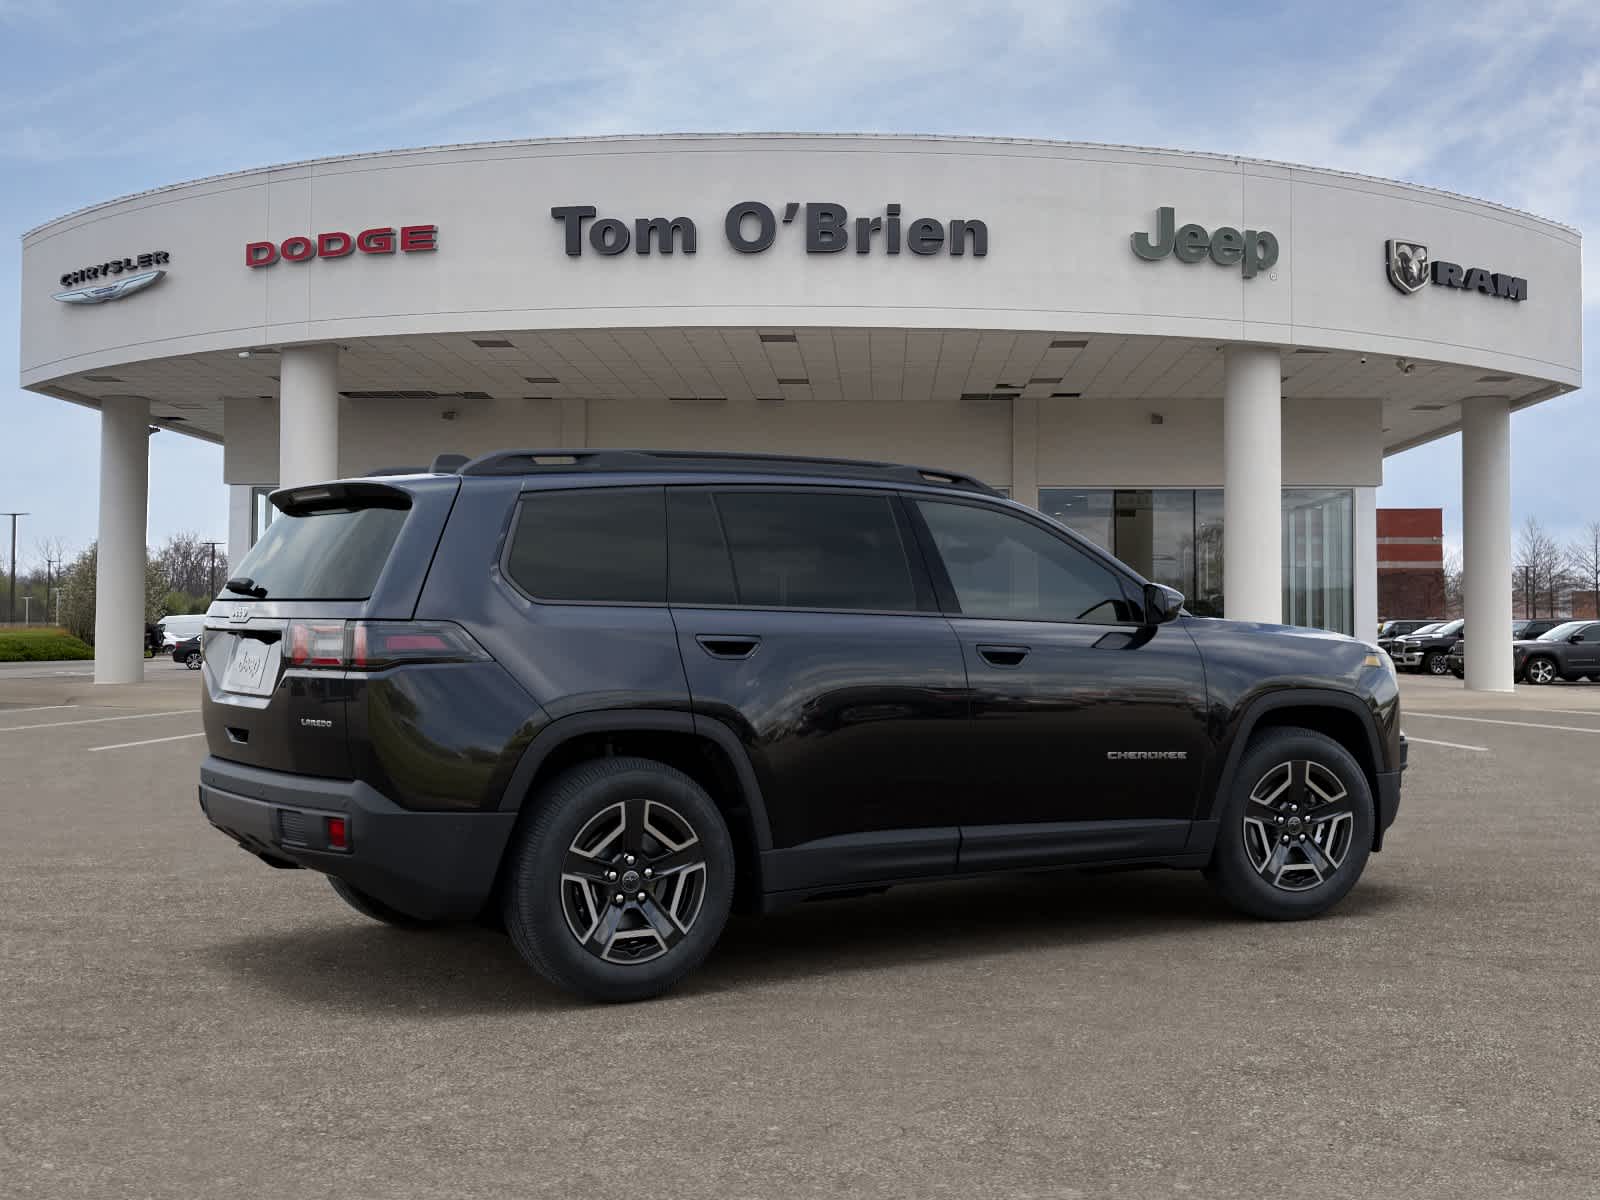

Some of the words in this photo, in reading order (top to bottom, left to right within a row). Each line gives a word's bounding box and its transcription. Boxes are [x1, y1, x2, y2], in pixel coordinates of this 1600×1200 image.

[246, 224, 437, 269] DODGE
[551, 205, 697, 256] Tom
[725, 201, 988, 256] O'Brien
[1130, 206, 1279, 279] Jeep
[60, 250, 170, 286] CHRYSLER
[1431, 260, 1527, 303] RAM
[1107, 751, 1188, 760] CHEROKEE
